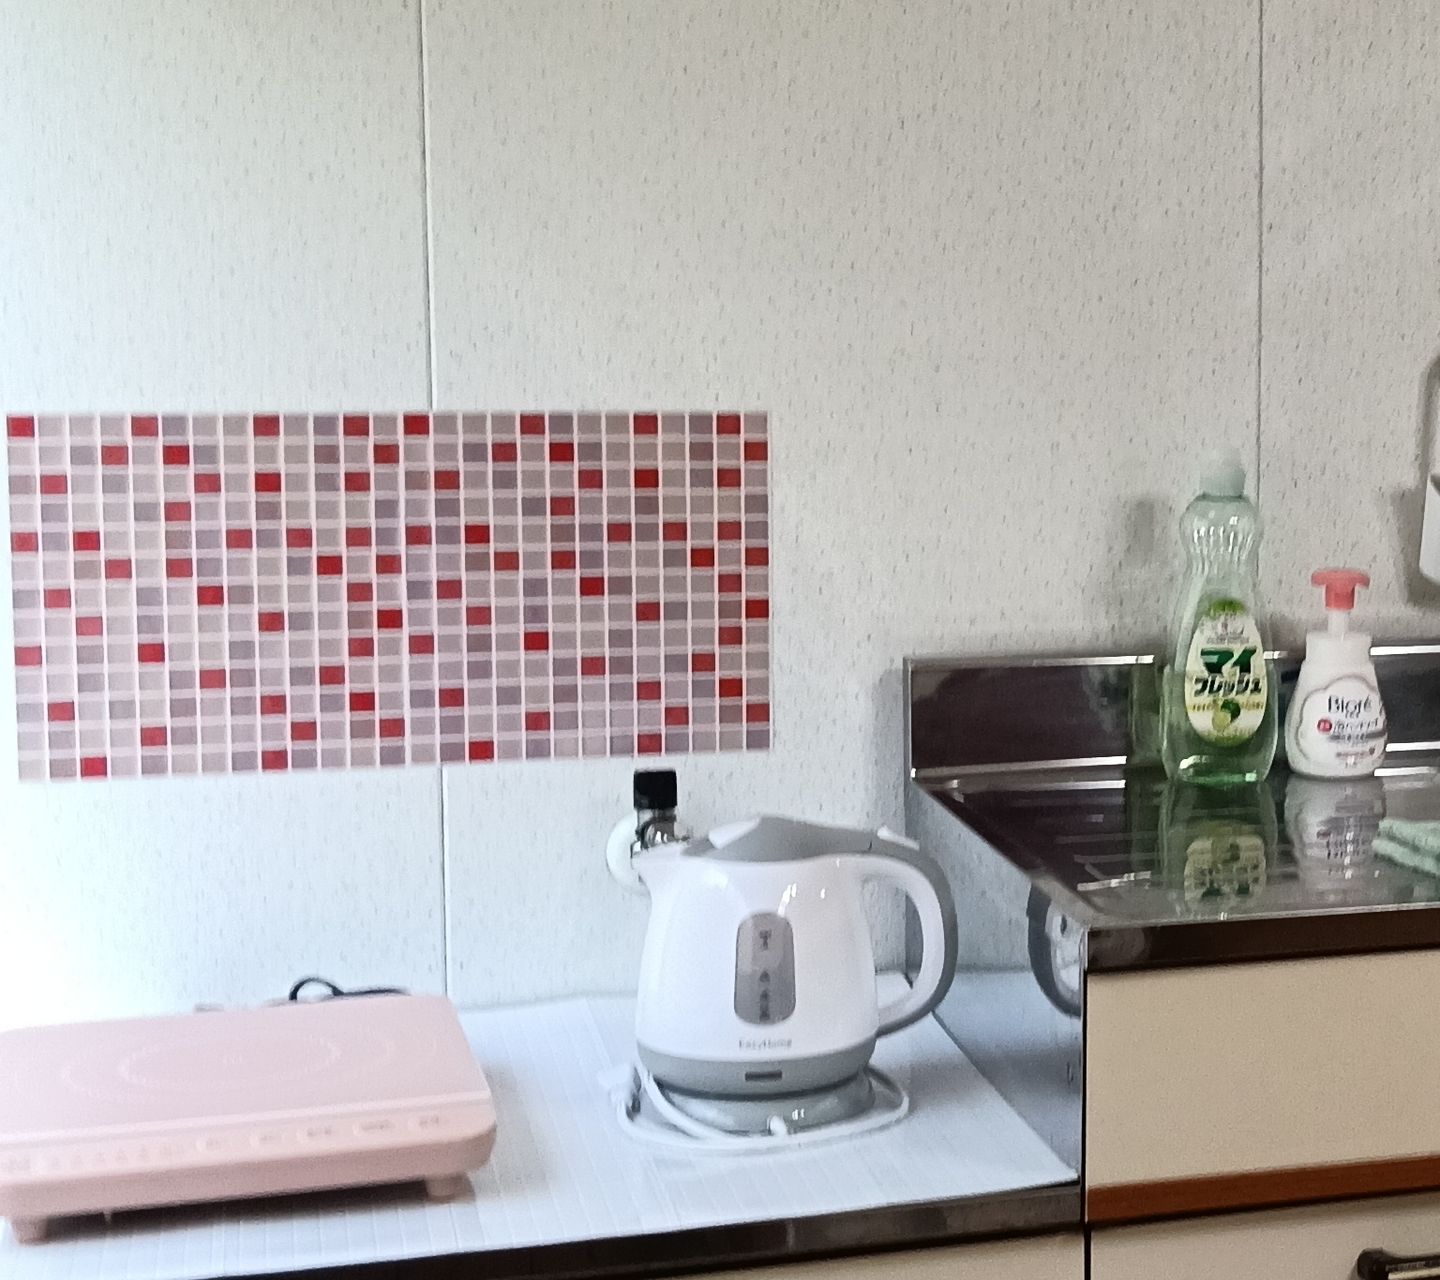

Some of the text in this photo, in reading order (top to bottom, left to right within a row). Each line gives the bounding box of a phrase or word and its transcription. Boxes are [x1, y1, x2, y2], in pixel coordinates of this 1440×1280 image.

[1193, 675, 1262, 698] フレッシュ
